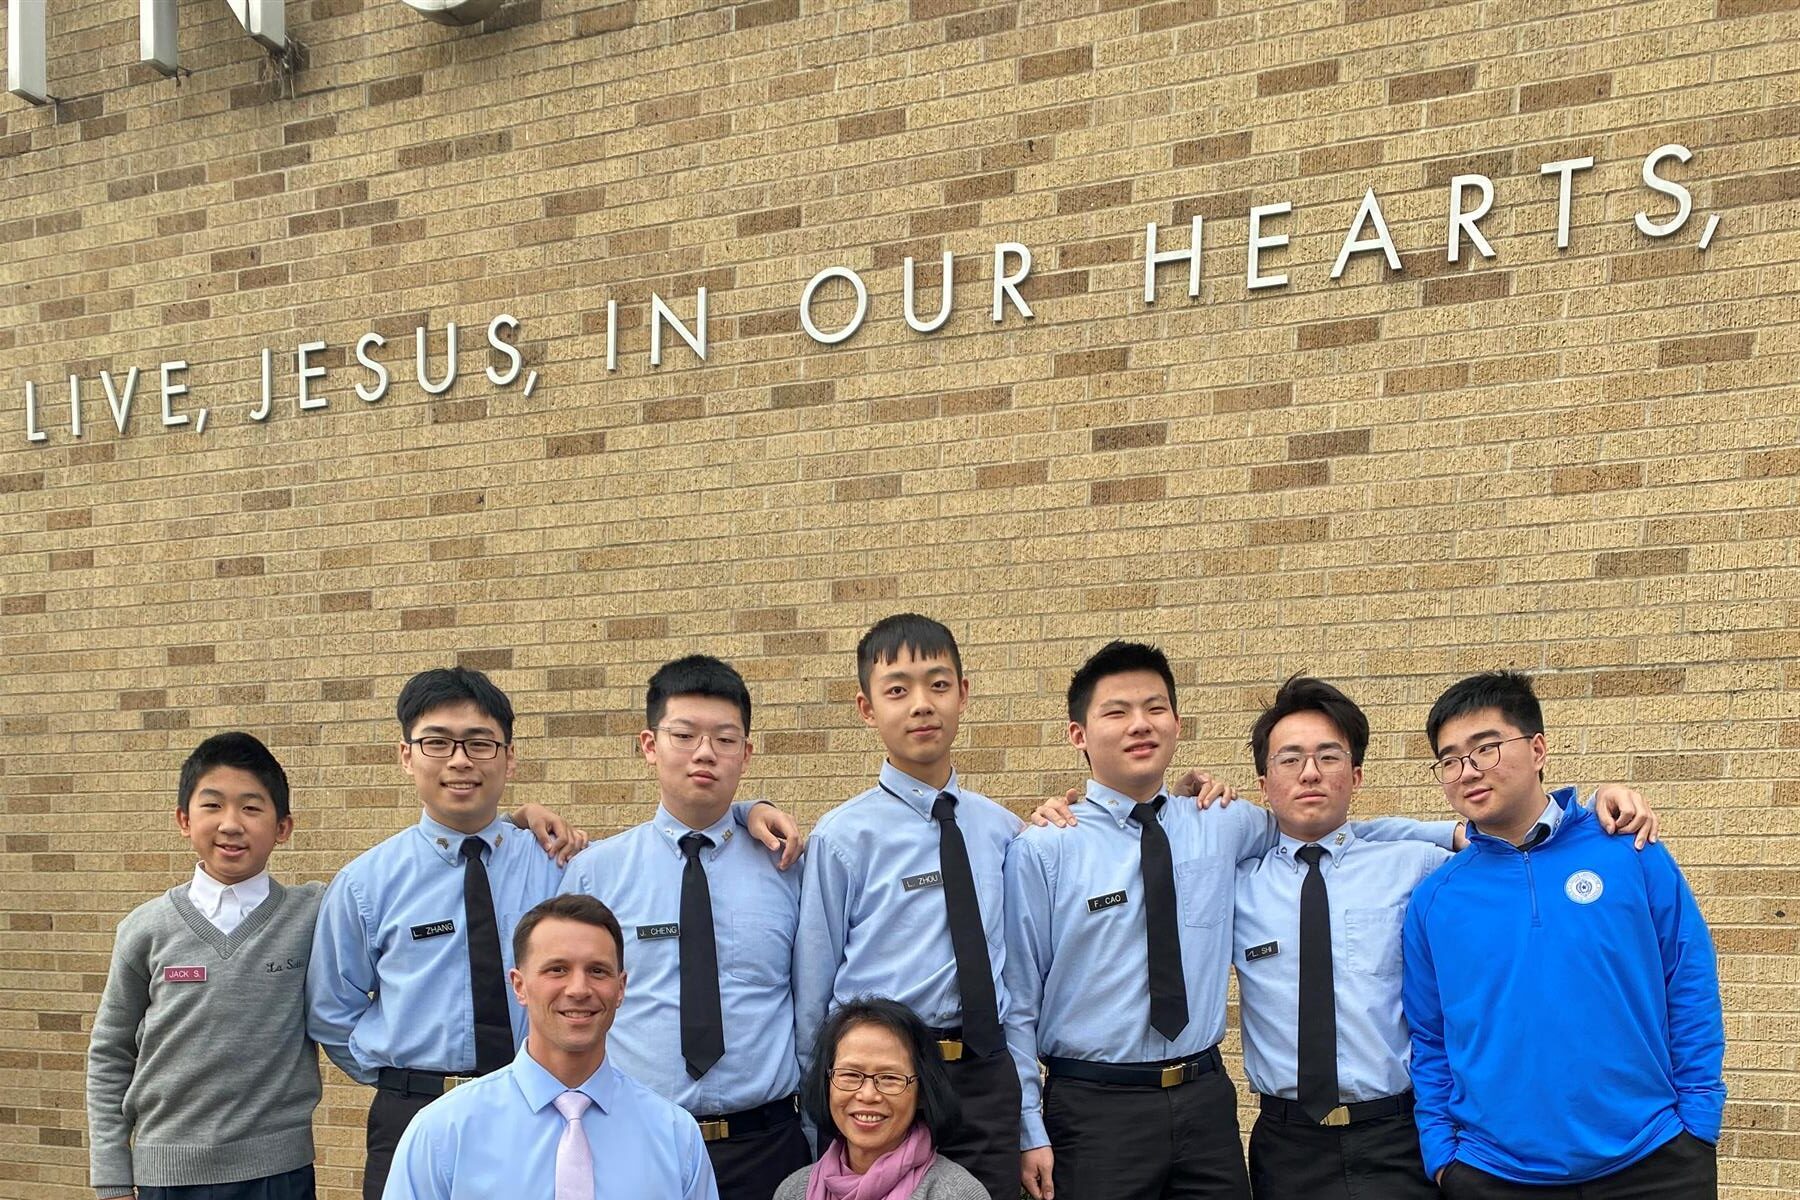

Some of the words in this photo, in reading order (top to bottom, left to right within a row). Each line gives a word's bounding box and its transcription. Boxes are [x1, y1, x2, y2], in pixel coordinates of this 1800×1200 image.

[26, 361, 209, 442] LIVE,
[250, 314, 538, 424] JESUS,
[607, 286, 708, 372] IN
[799, 241, 1034, 345] OUR
[1144, 143, 1722, 303] HEARTS,
[918, 874, 938, 885] ZHOU
[1094, 900, 1102, 908] F.
[1105, 894, 1122, 905] CAO
[425, 922, 453, 935] ZHANG
[650, 926, 677, 936] CHENG
[169, 970, 190, 978] JACK
[193, 969, 201, 978] S.
